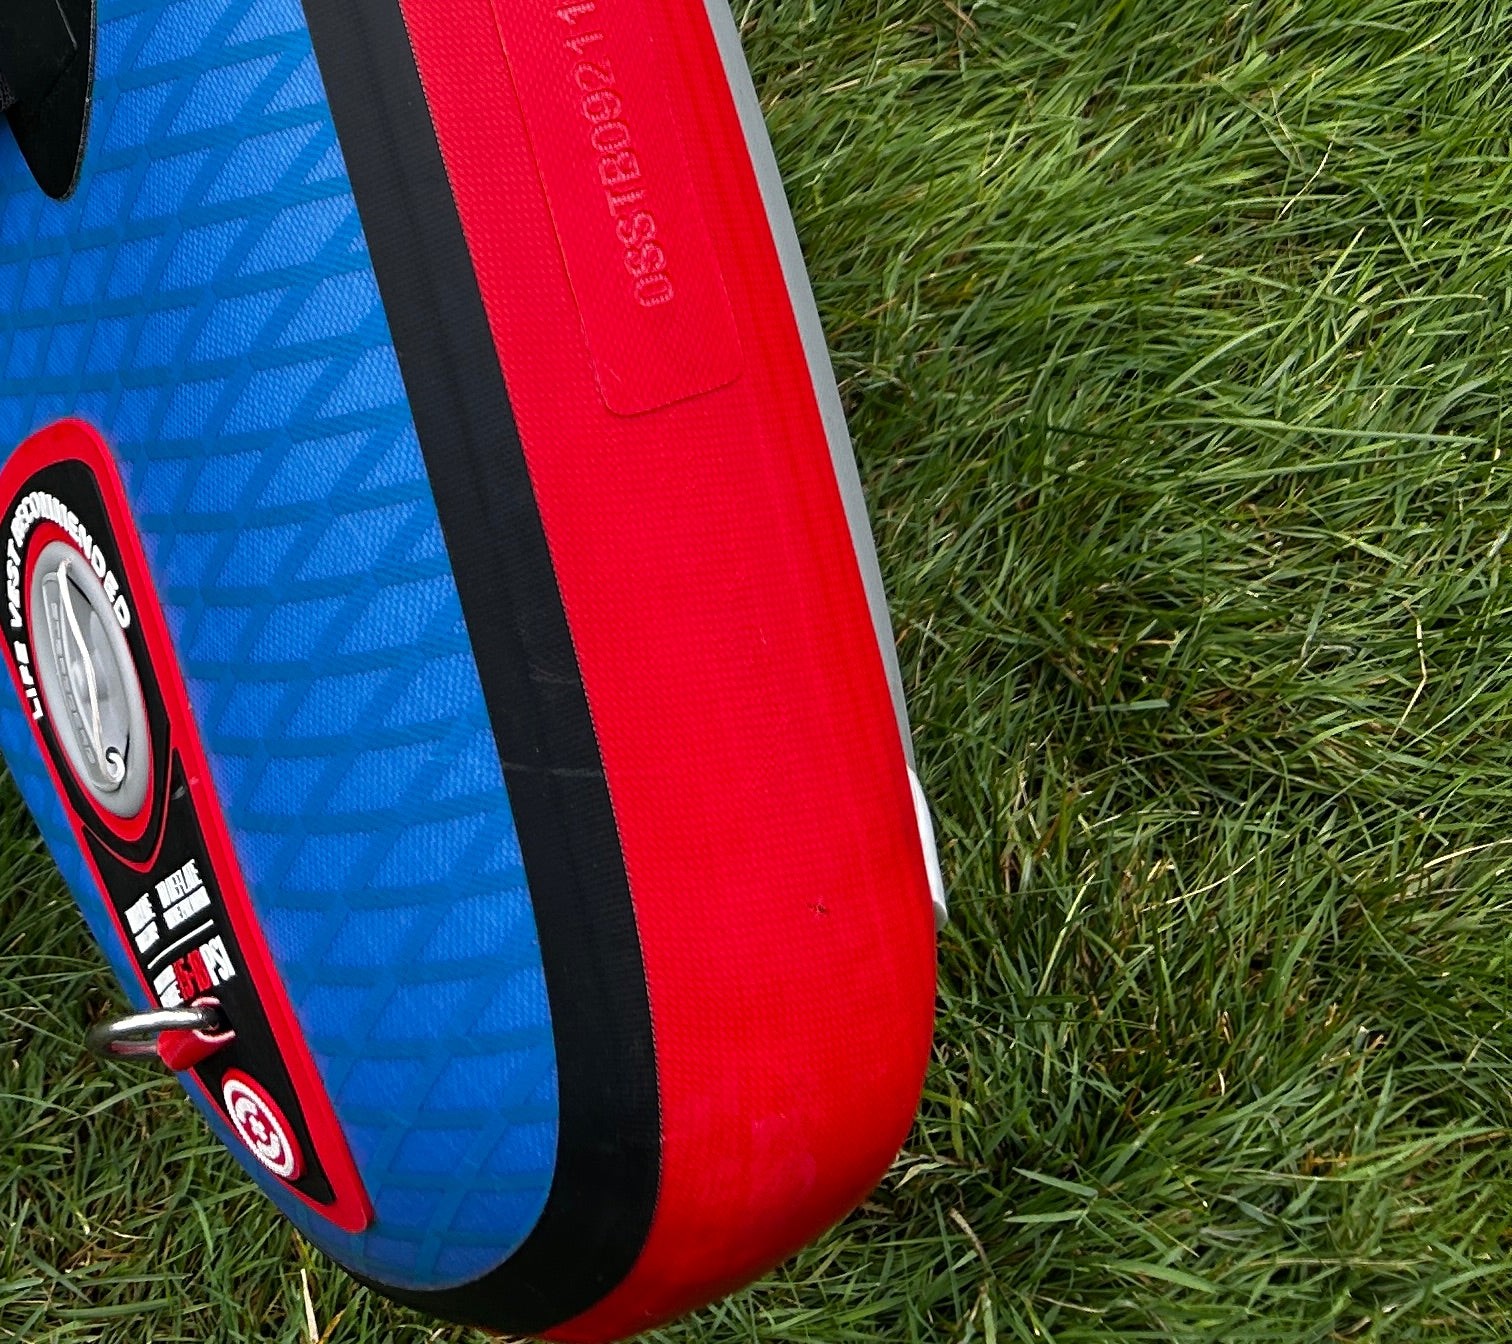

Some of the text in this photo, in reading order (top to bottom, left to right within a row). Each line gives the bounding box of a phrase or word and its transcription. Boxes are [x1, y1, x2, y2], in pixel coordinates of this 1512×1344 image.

[6, 491, 131, 720] LIFE VEST RECOMMENDED
